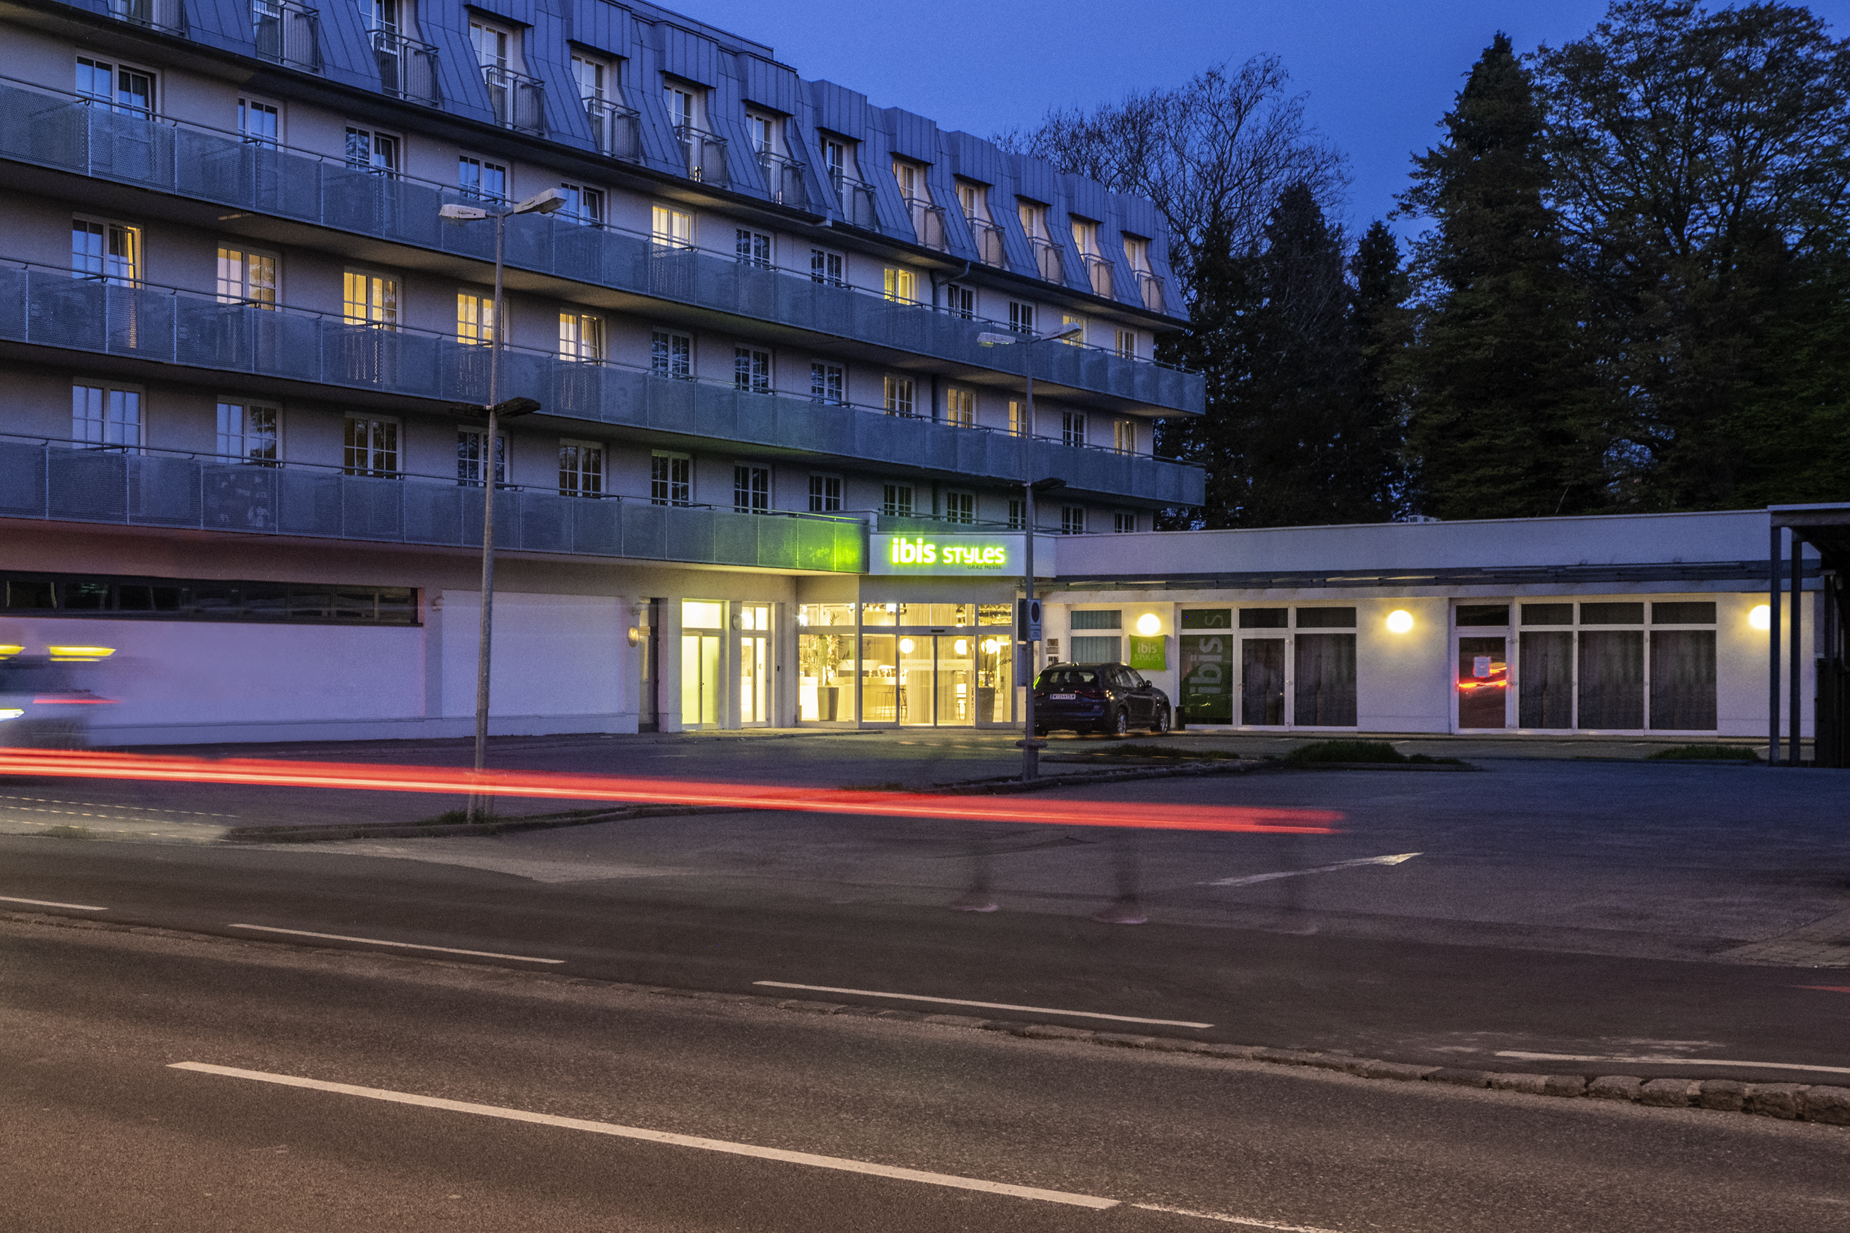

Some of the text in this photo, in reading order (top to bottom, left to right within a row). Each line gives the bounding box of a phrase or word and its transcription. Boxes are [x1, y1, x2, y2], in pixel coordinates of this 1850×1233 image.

[892, 537, 937, 563] ibis
[1138, 642, 1157, 653] ibis
[1189, 637, 1223, 694] ibis
